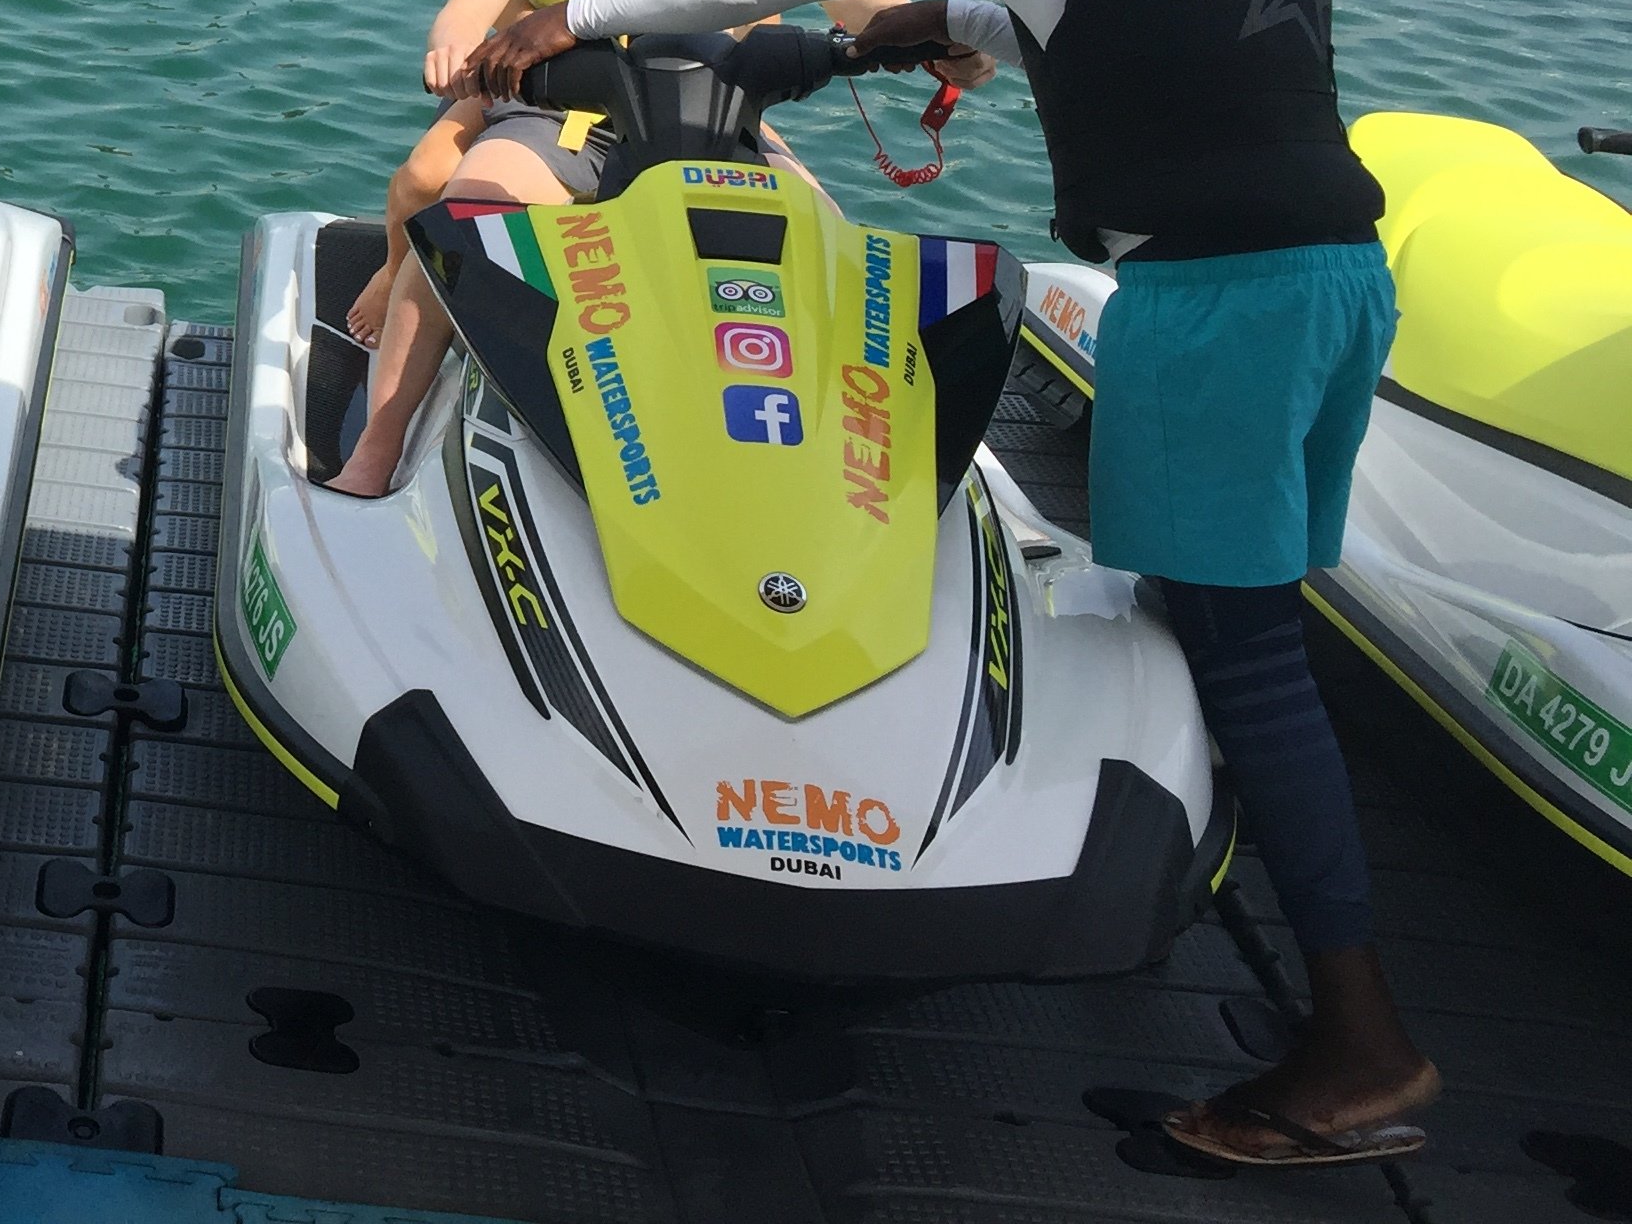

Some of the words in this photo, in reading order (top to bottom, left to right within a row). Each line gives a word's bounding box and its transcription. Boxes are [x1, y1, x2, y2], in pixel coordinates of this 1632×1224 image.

[556, 211, 631, 335] NEMO
[864, 234, 891, 368] WATERSPORTS
[1039, 285, 1086, 341] NEMO
[562, 347, 584, 393] DUBAI
[904, 341, 917, 386] DUBAI
[585, 336, 660, 506] WATERSPORTS
[842, 364, 891, 524] NEMO
[259, 610, 284, 661] JS
[1500, 656, 1537, 716] DA
[1539, 695, 1610, 766] 4279
[1610, 760, 1632, 787] J
[716, 779, 901, 846] NEMO
[716, 827, 902, 872] WATERSPORTS
[770, 857, 841, 881] DUBAI
